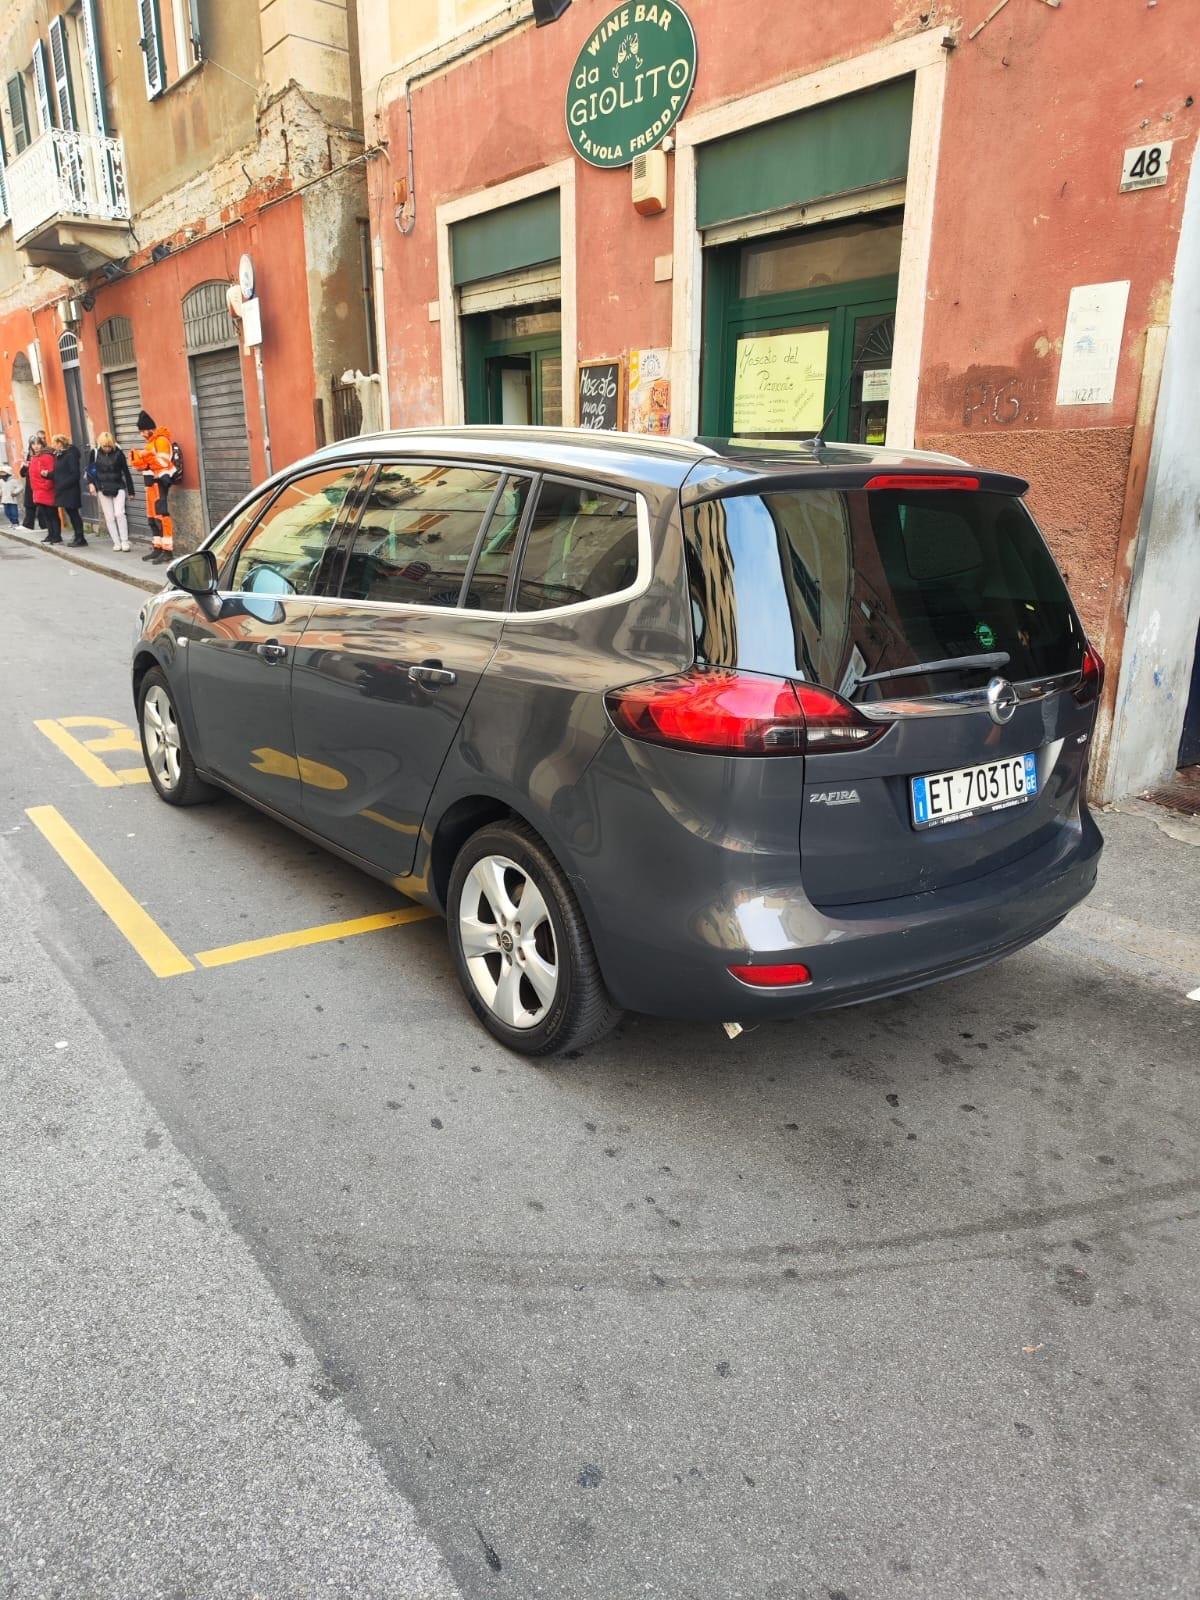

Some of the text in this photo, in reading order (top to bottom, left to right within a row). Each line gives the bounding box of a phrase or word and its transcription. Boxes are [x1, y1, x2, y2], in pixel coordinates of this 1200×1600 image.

[587, 4, 672, 57] WINE BAR
[570, 58, 689, 126] GIOLITO
[575, 66, 599, 89] da
[578, 95, 682, 160] TAVOLA FREDDA
[1129, 147, 1162, 178] 48
[809, 788, 860, 803] ZAFIRA
[928, 775, 954, 814] ET
[963, 760, 1024, 806] 703TG
[1026, 775, 1037, 790] GE
